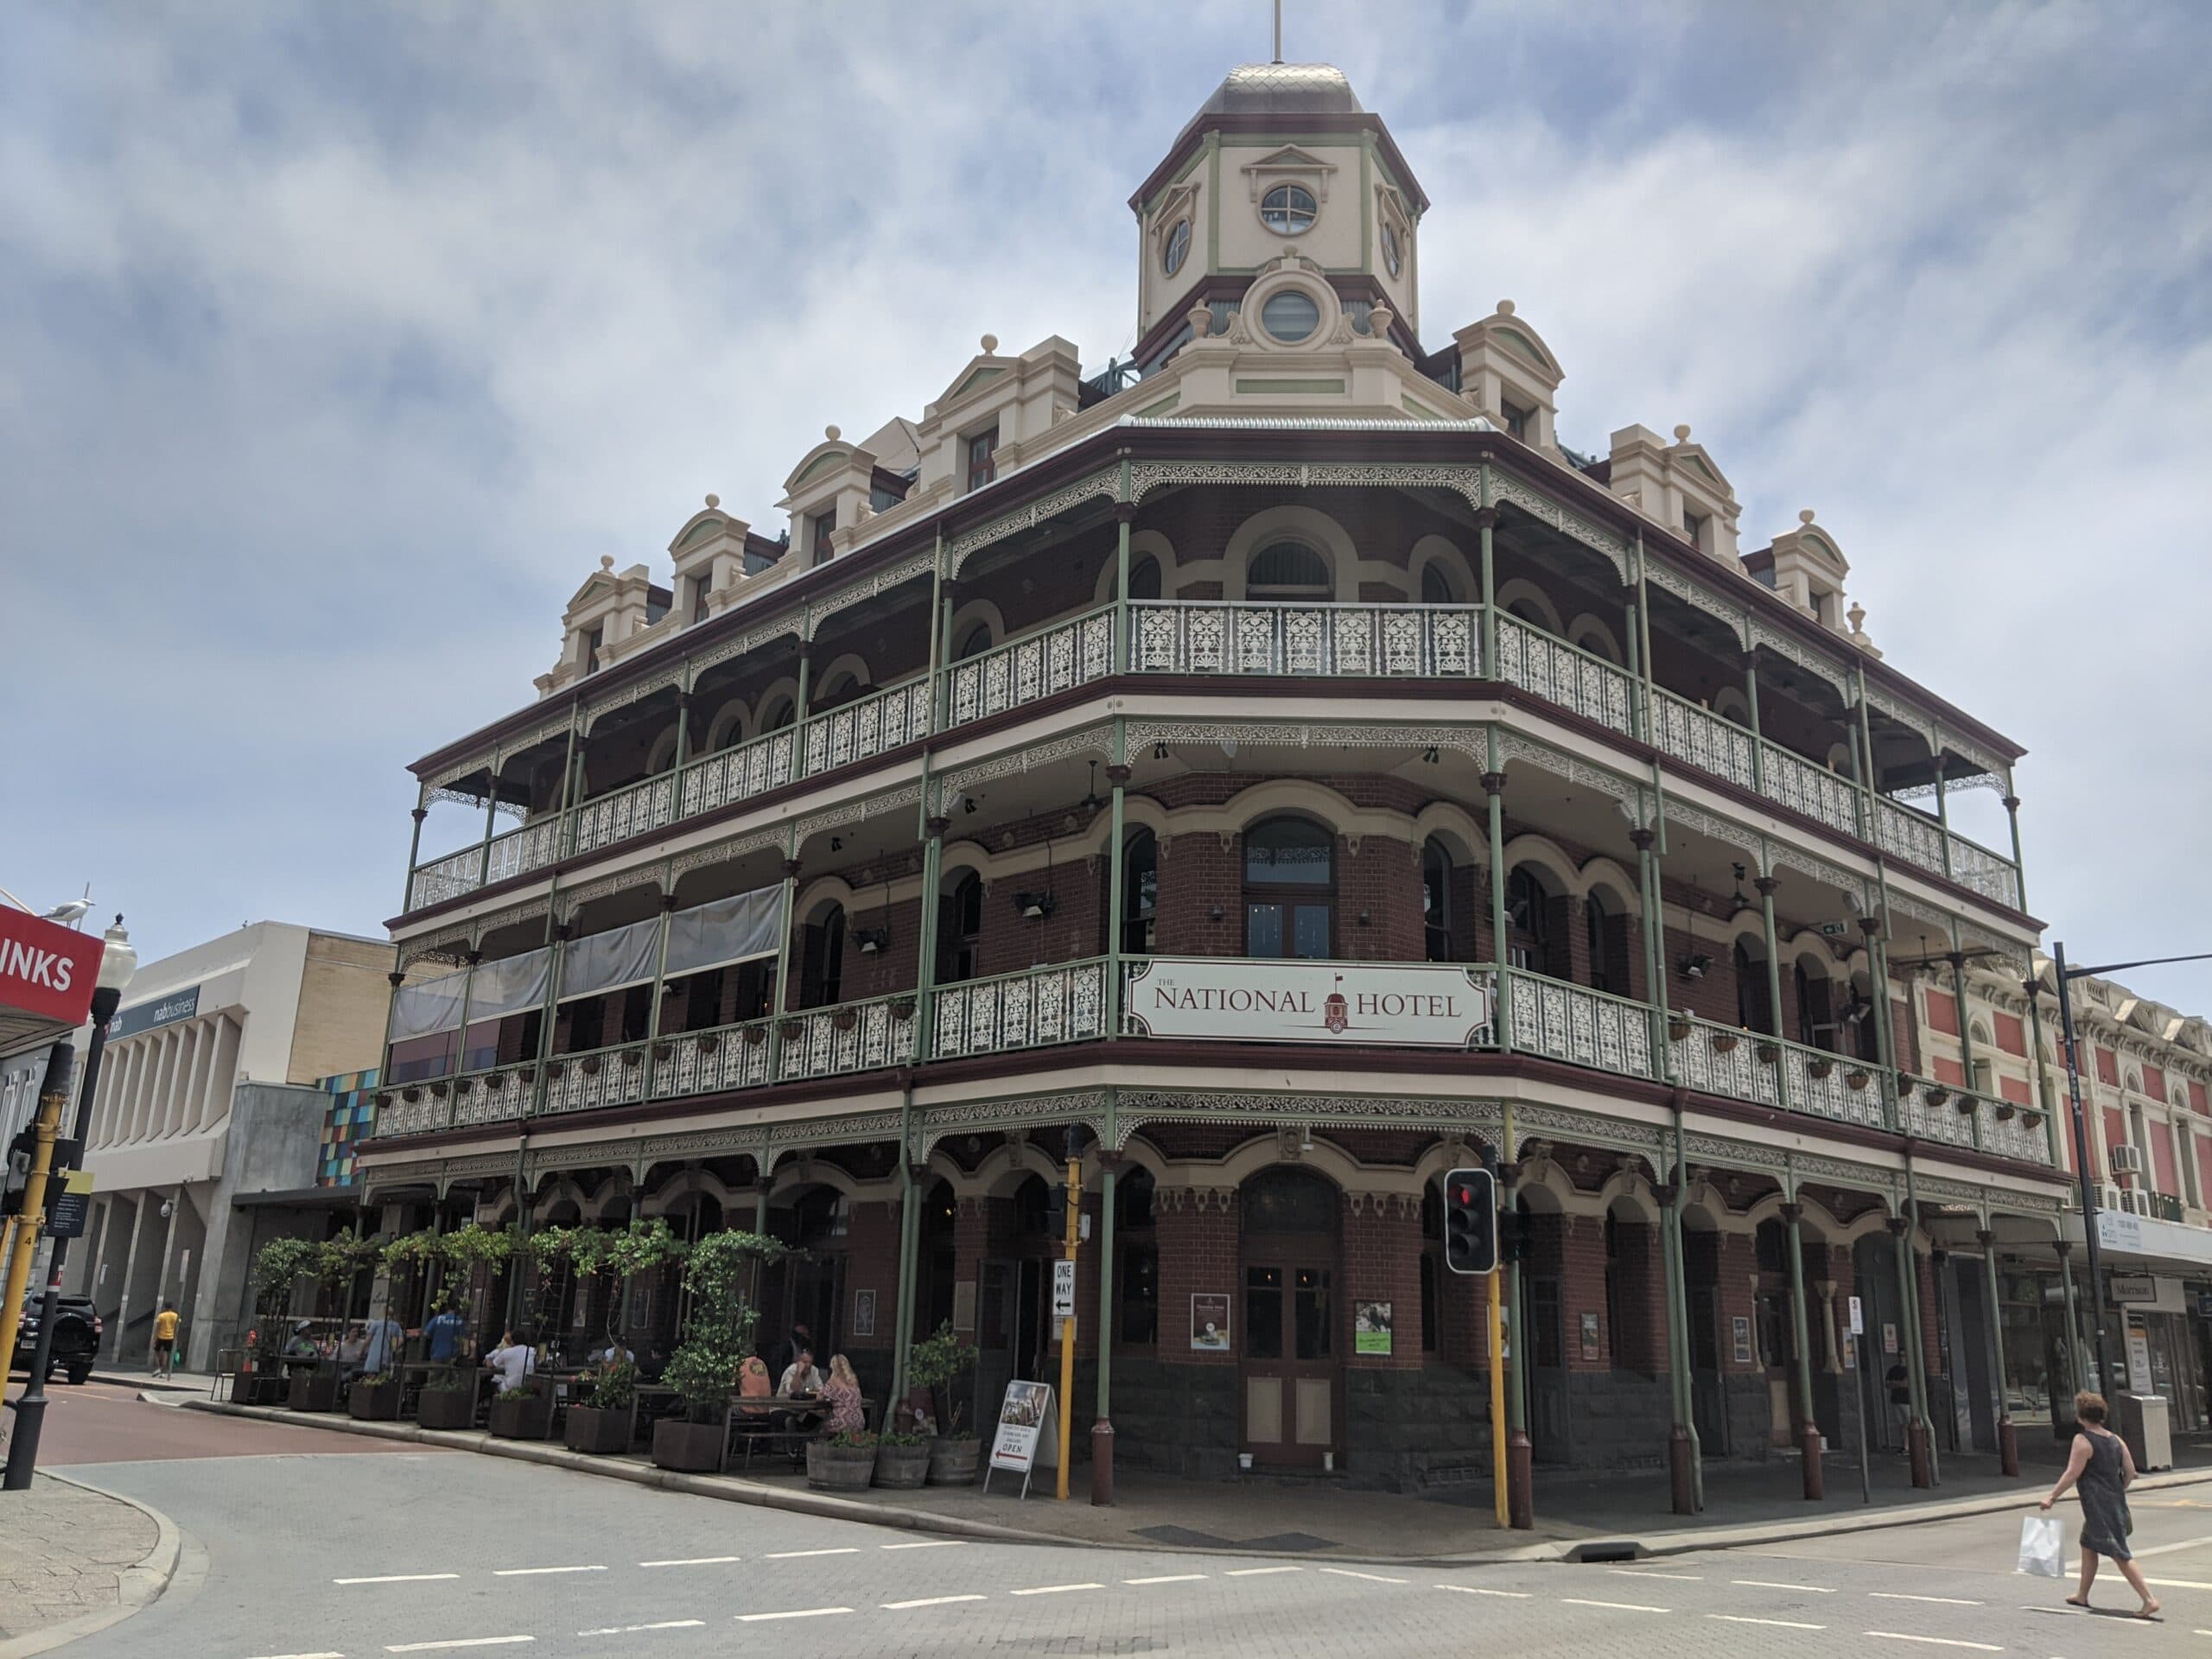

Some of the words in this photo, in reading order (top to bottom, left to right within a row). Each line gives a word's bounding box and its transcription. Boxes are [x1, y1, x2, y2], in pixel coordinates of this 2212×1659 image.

[1158, 978, 1175, 987] THE
[1154, 987, 1315, 1014] NATIONAL
[1357, 993, 1462, 1018] HOTEL
[110, 1017, 122, 1032] nab
[25, 1236, 32, 1246] 4
[1057, 1264, 1071, 1278] ONE
[1056, 1283, 1071, 1295] WAY
[1002, 1443, 1023, 1452] OPEN
